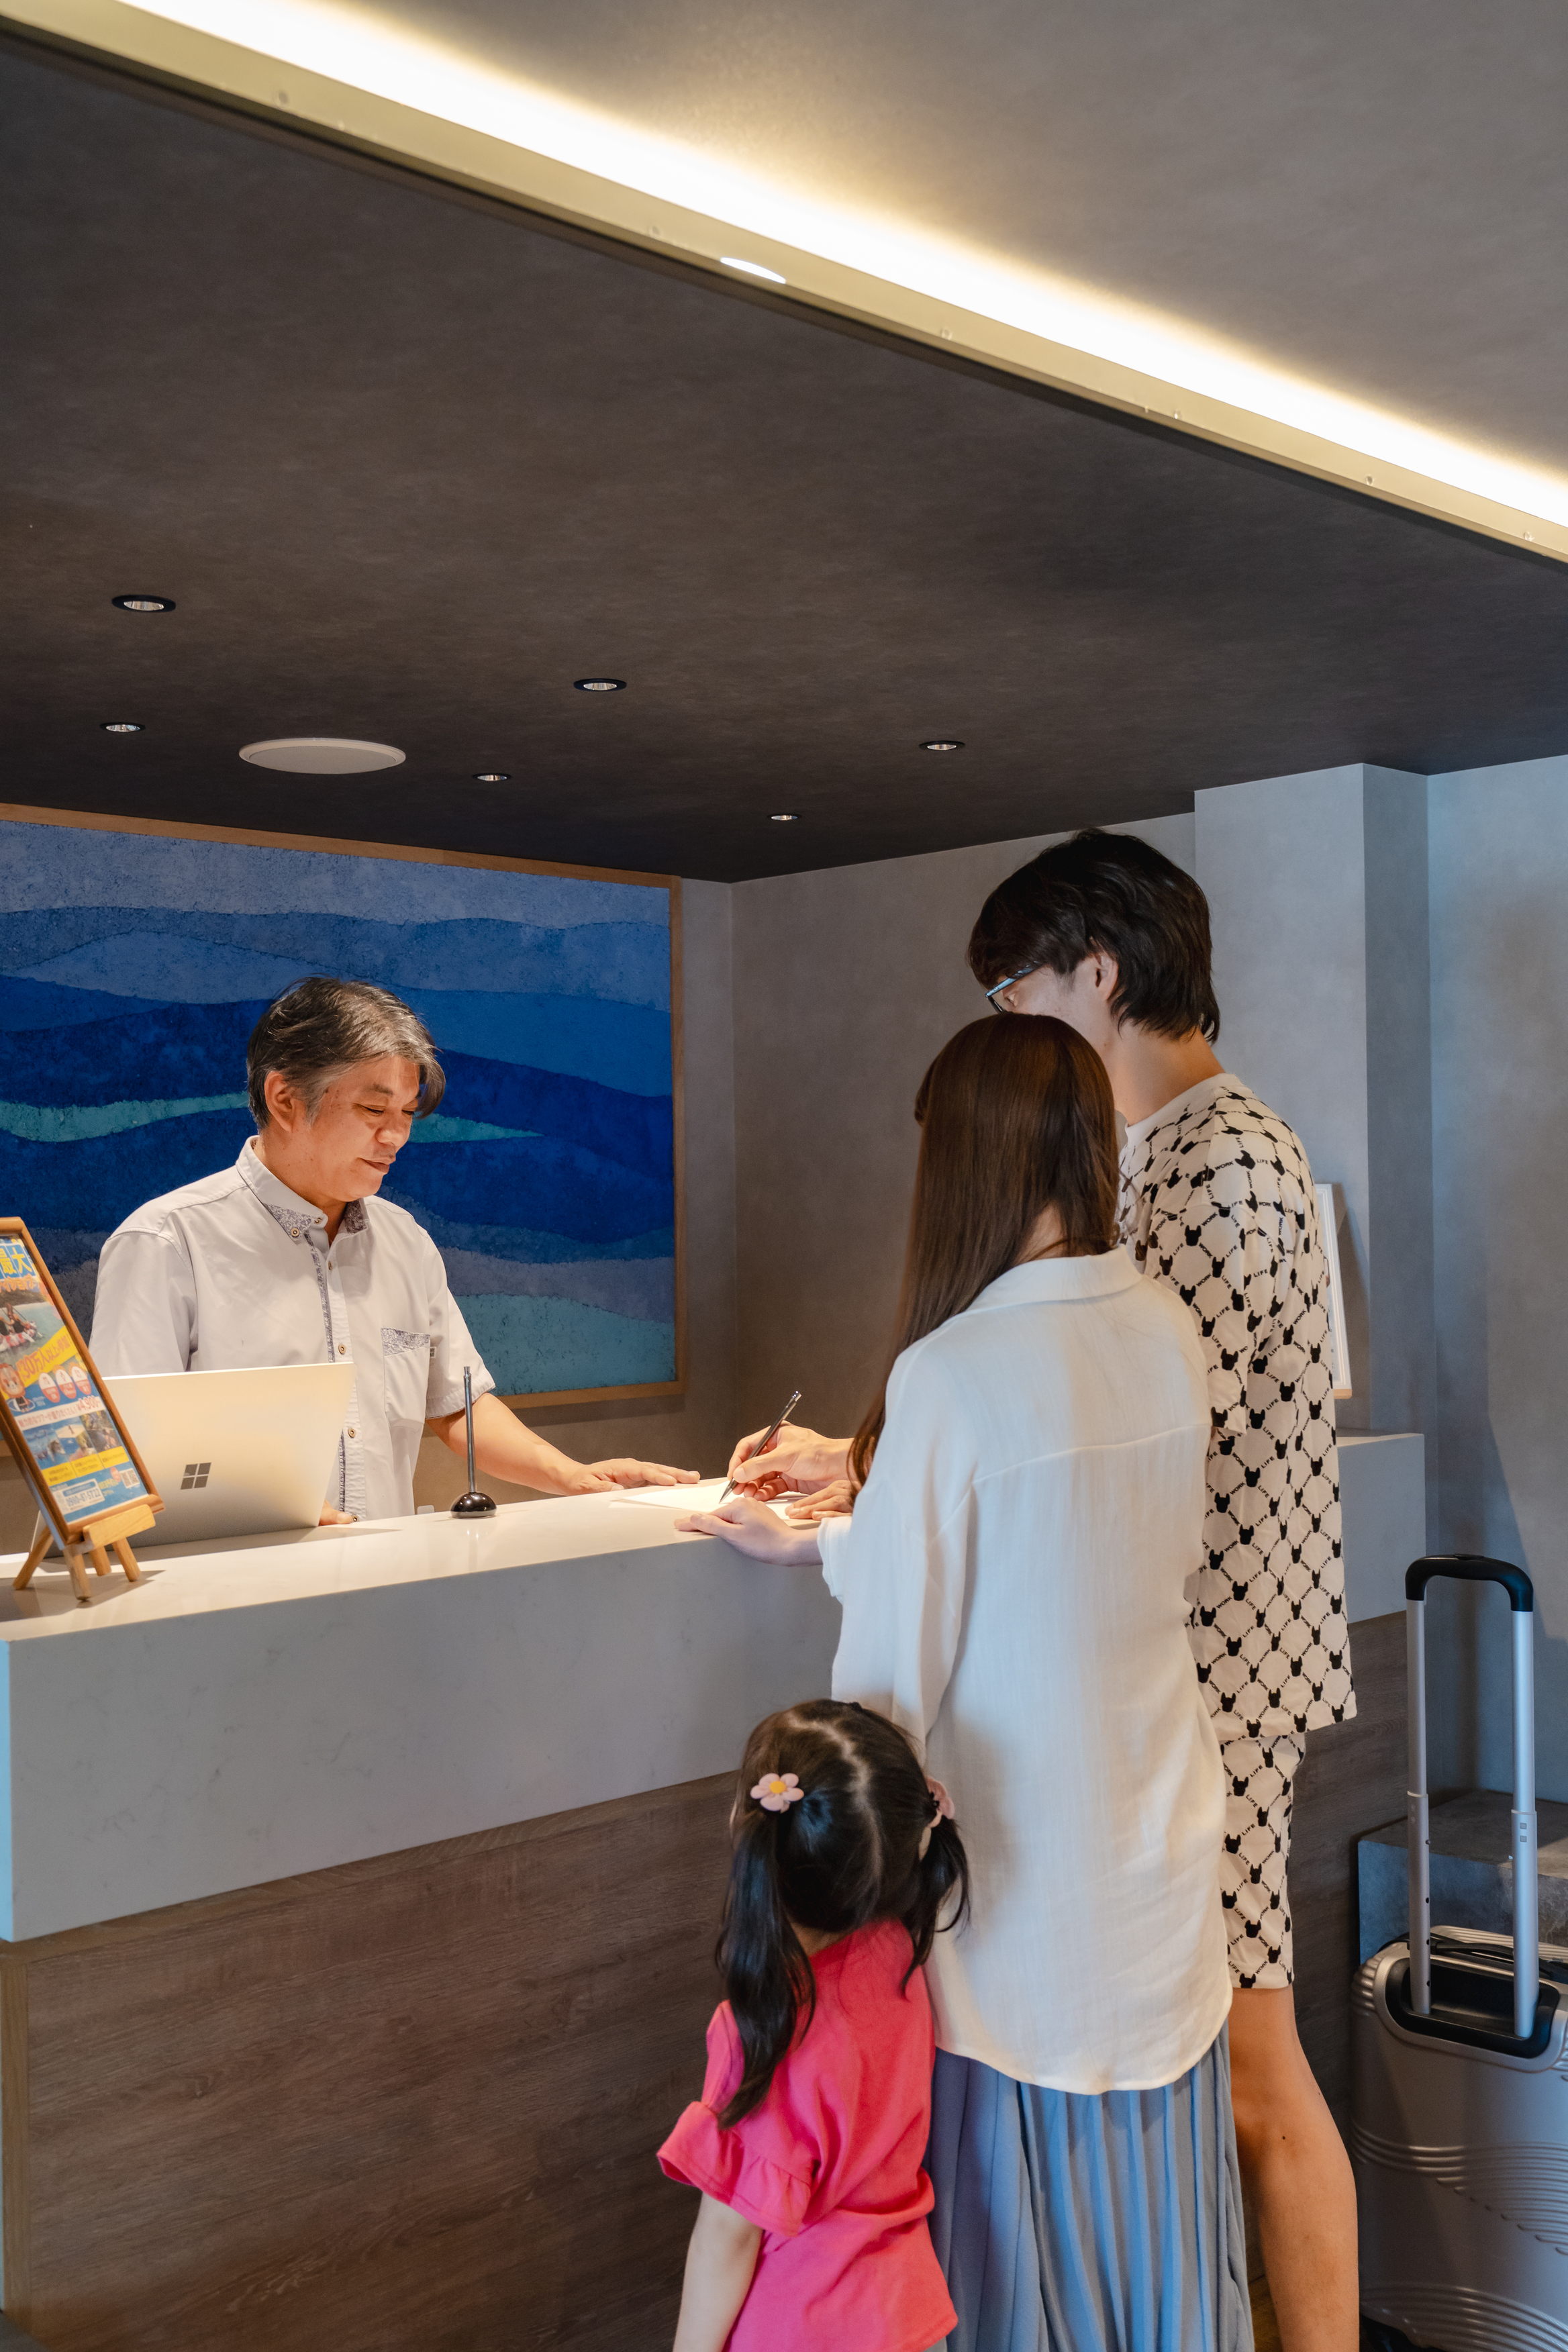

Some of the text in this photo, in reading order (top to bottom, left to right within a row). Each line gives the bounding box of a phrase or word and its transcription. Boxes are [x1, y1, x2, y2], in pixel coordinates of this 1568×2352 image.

[1215, 1161, 1234, 1170] WORK
[1206, 1184, 1214, 1199] LIFE
[1155, 1218, 1167, 1231] WORK
[1202, 1212, 1218, 1226] WORK
[1173, 1243, 1184, 1255] LIFE
[1199, 1242, 1213, 1259] WORK
[1226, 1245, 1238, 1258] LIFE
[1254, 1269, 1268, 1277] LIFE
[1196, 1273, 1211, 1287] WORK
[1221, 1275, 1231, 1289] LIFE
[1216, 1306, 1230, 1318] LIFE
[1293, 1309, 1306, 1325] WORK
[1212, 1335, 1222, 1349] LIFE
[1320, 1330, 1328, 1342] LIFE
[1269, 1344, 1281, 1357] LIFE
[1208, 1365, 1218, 1374] IFE
[1267, 1372, 1279, 1383] LIFE
[1322, 1387, 1330, 1400] LIFE
[1266, 1399, 1279, 1410] LIFE
[1263, 1427, 1275, 1440] LIFE
[1323, 1444, 1332, 1456] LIFE
[1232, 1452, 1245, 1467] WORK
[1261, 1456, 1274, 1468] LIFE
[1322, 1474, 1332, 1484] LIFE
[1230, 1482, 1245, 1495] WORK
[1258, 1485, 1269, 1498] LIFE
[1322, 1500, 1332, 1512] LIFE
[1206, 1509, 1214, 1519] IFE
[1228, 1510, 1240, 1526] WORK
[1255, 1514, 1267, 1526] LIFE
[1302, 1530, 1312, 1544] WORK
[1320, 1529, 1331, 1540] LIFE
[1224, 1540, 1239, 1552] WORK
[1252, 1542, 1263, 1555] LIFE
[1320, 1557, 1331, 1568] LIFE
[1220, 1567, 1233, 1582] WORK
[1249, 1571, 1262, 1582] LIFE
[1301, 1586, 1312, 1600] WORK
[1320, 1585, 1330, 1596] LIFE
[1216, 1596, 1232, 1608] WORK
[1245, 1598, 1257, 1610] LIFE
[1267, 1594, 1277, 1608] WORK
[1320, 1612, 1330, 1624] LIFE
[1214, 1623, 1226, 1638] WORK
[1281, 1618, 1291, 1631] LIFE
[1242, 1626, 1255, 1638] LIFE
[1279, 1648, 1290, 1659] LIFE
[1302, 1642, 1313, 1657] WORK
[1212, 1652, 1227, 1664] WORK
[1240, 1654, 1251, 1666] LIFE
[1259, 1649, 1271, 1663] WORK
[1210, 1679, 1220, 1694] WORK
[1281, 1675, 1290, 1687] LIFE
[1237, 1681, 1248, 1694] LIFE
[1234, 1710, 1244, 1720] LIFE
[1258, 1705, 1269, 1719] WORK
[1250, 1765, 1263, 1777] LIFE
[1246, 1794, 1259, 1808] LIFE
[1242, 1824, 1255, 1836] LIFE
[1239, 1853, 1250, 1865] LIFE
[1237, 1879, 1248, 1892] LIFE
[1235, 1908, 1246, 1920] LIFE
[1230, 1934, 1244, 1945] LIFE
[1228, 1961, 1240, 1973] LIFE
[1256, 1961, 1268, 1974] WORK
